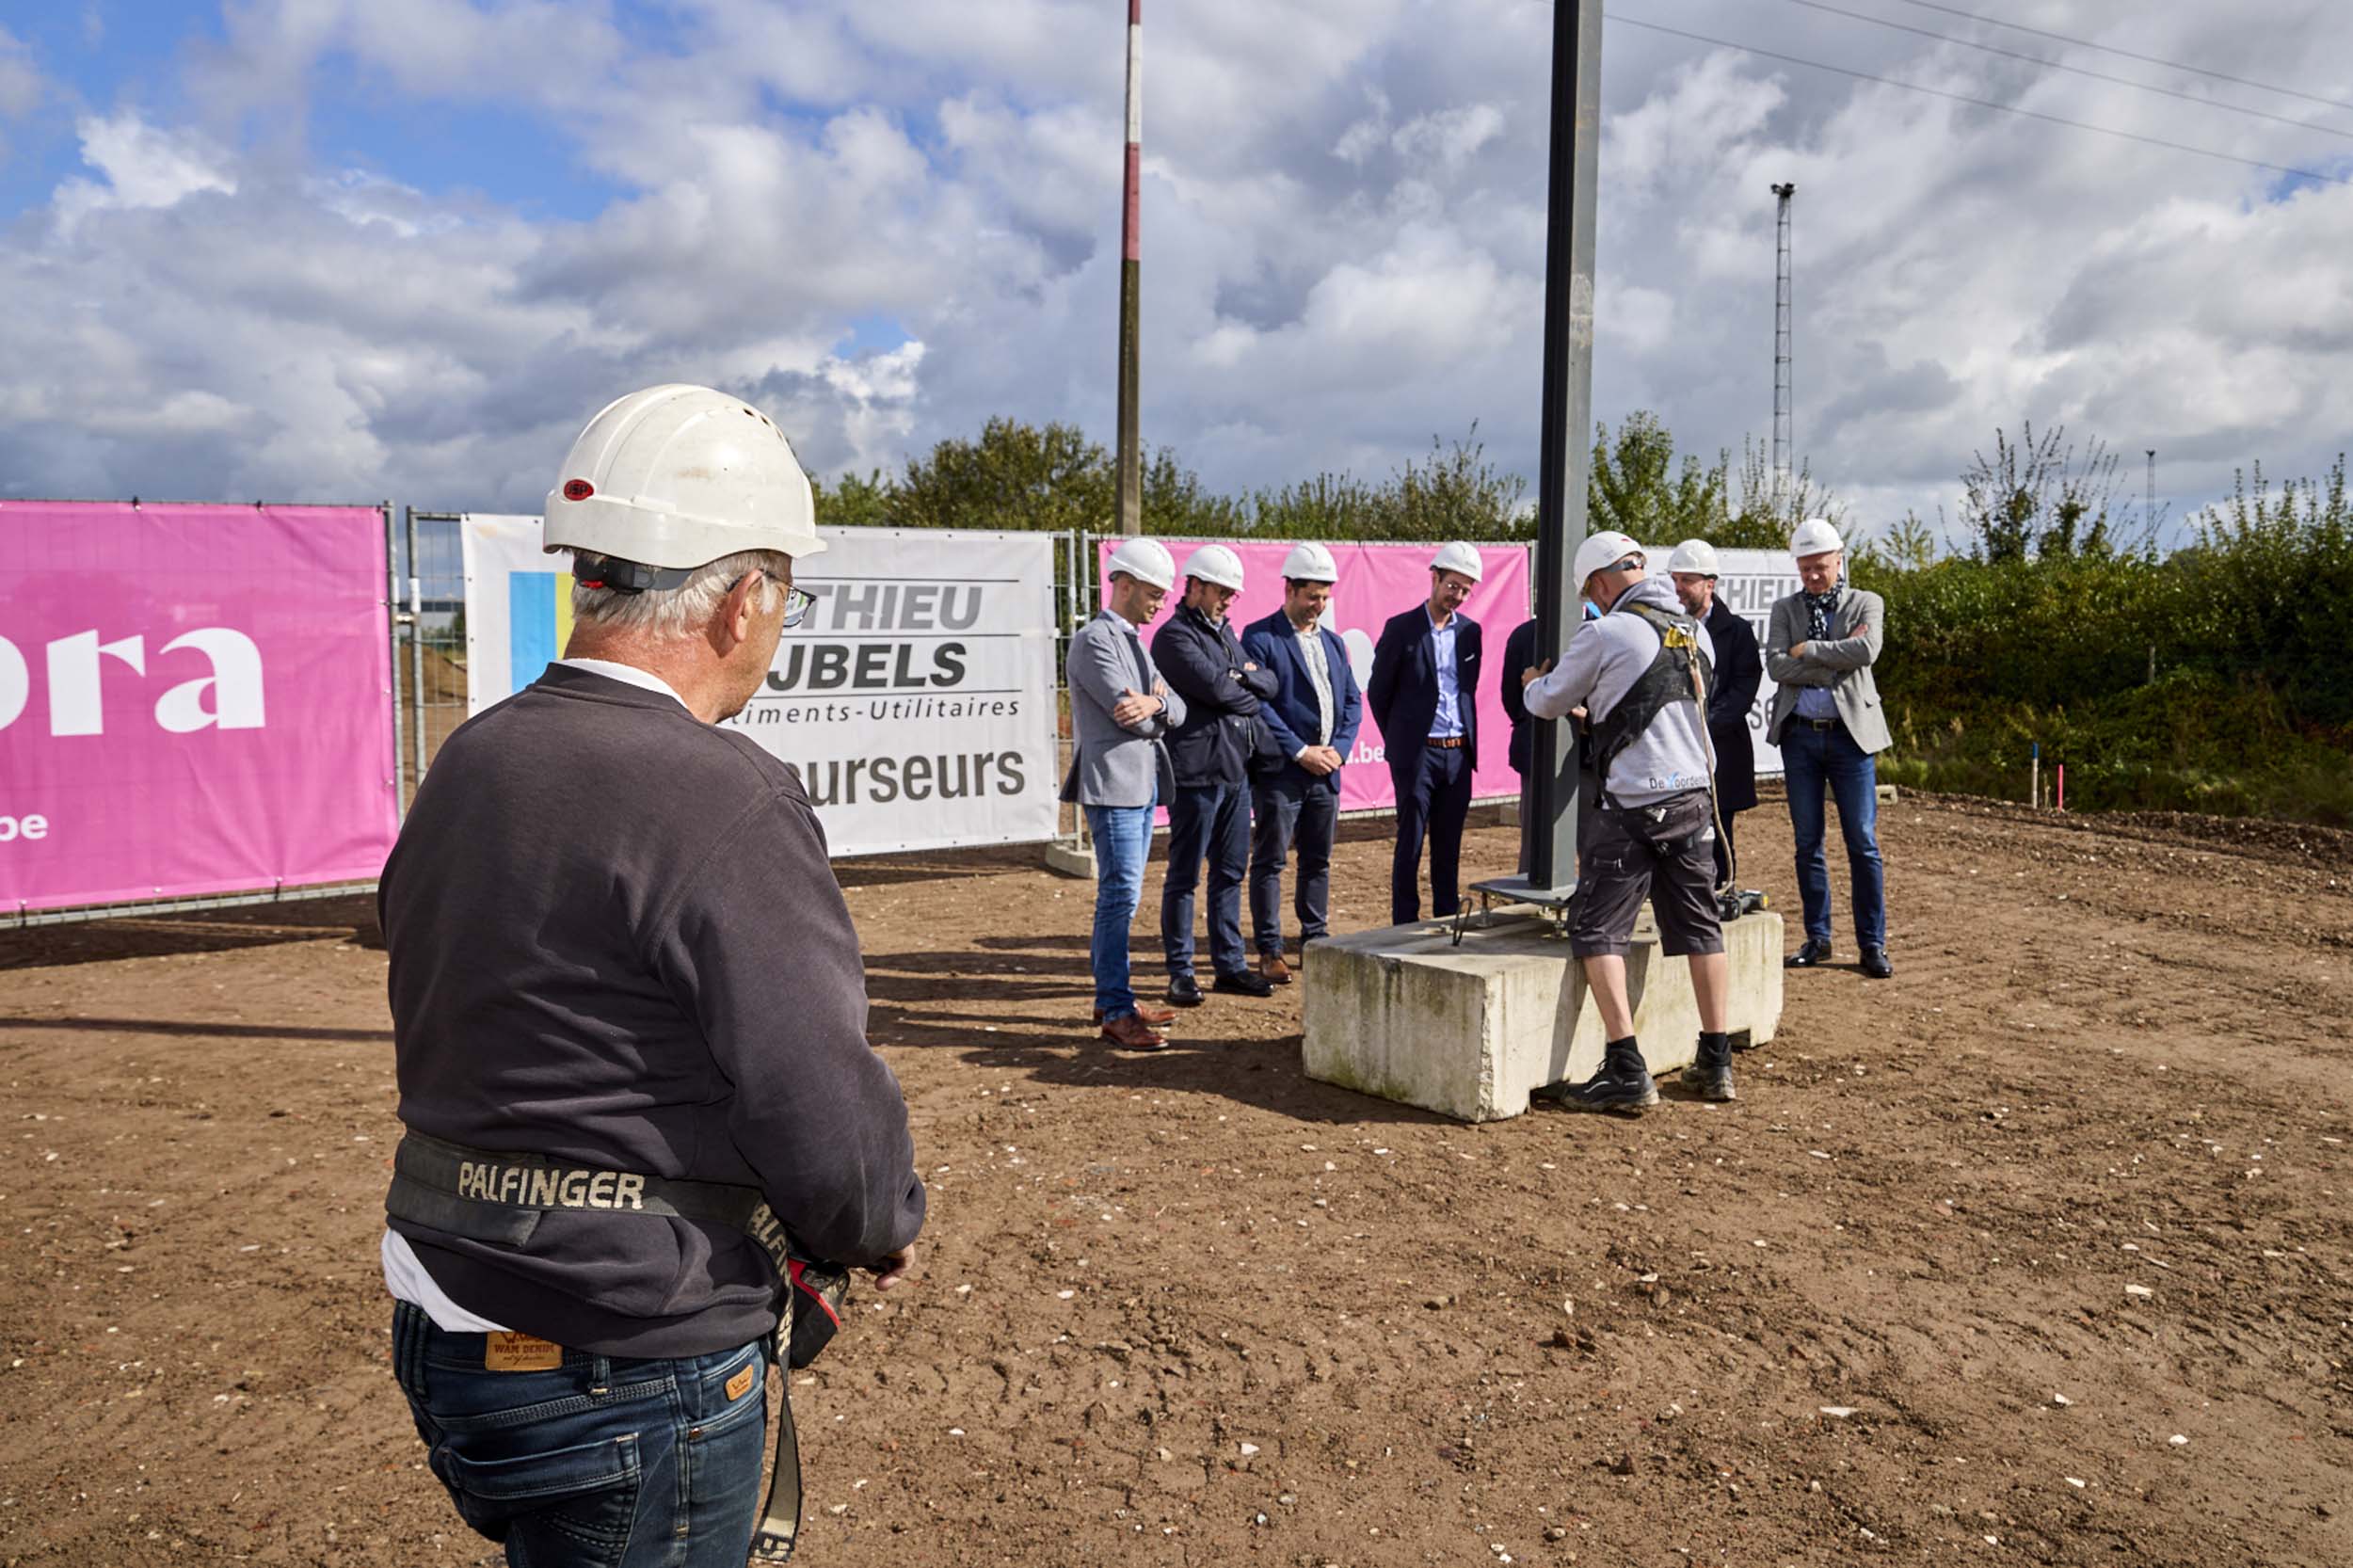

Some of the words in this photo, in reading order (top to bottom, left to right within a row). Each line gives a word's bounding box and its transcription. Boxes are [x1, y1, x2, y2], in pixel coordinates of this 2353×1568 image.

[766, 642, 968, 692] JBELS
[784, 751, 1026, 808] urseurs
[1649, 776, 1665, 790] De
[458, 1161, 646, 1209] PALFINGER
